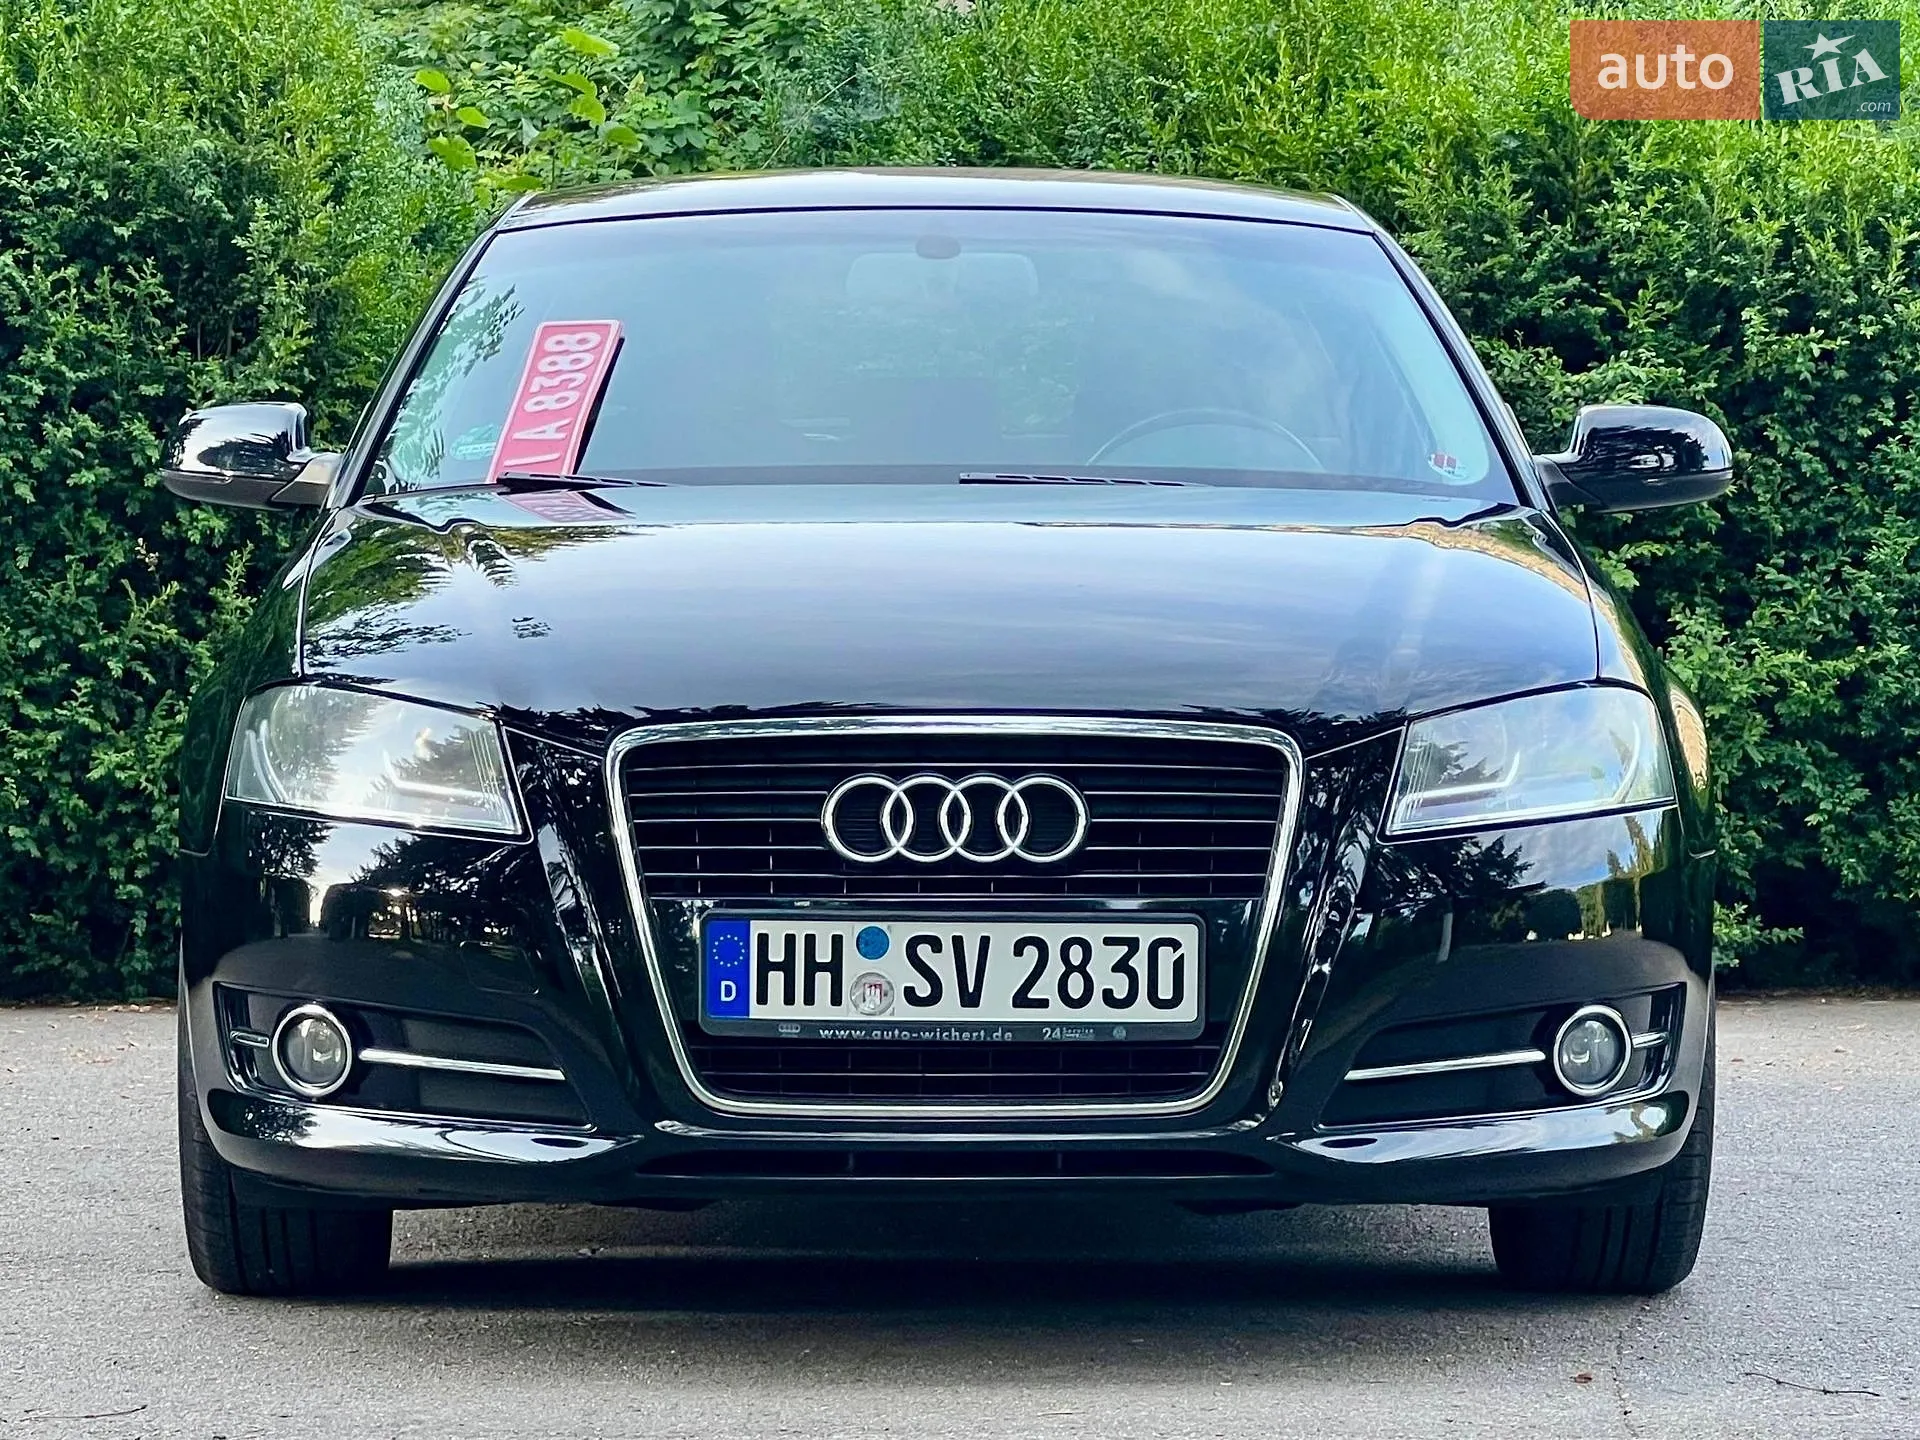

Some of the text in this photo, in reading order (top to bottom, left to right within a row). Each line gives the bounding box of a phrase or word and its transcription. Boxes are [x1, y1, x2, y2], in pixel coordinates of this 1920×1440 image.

[523, 331, 601, 413] 8388
[720, 980, 737, 1002] D
[756, 932, 1185, 1010] HH SV 2830
[819, 1025, 1013, 1041] www.auto-wichert.de
[1042, 1026, 1061, 1041] 24
